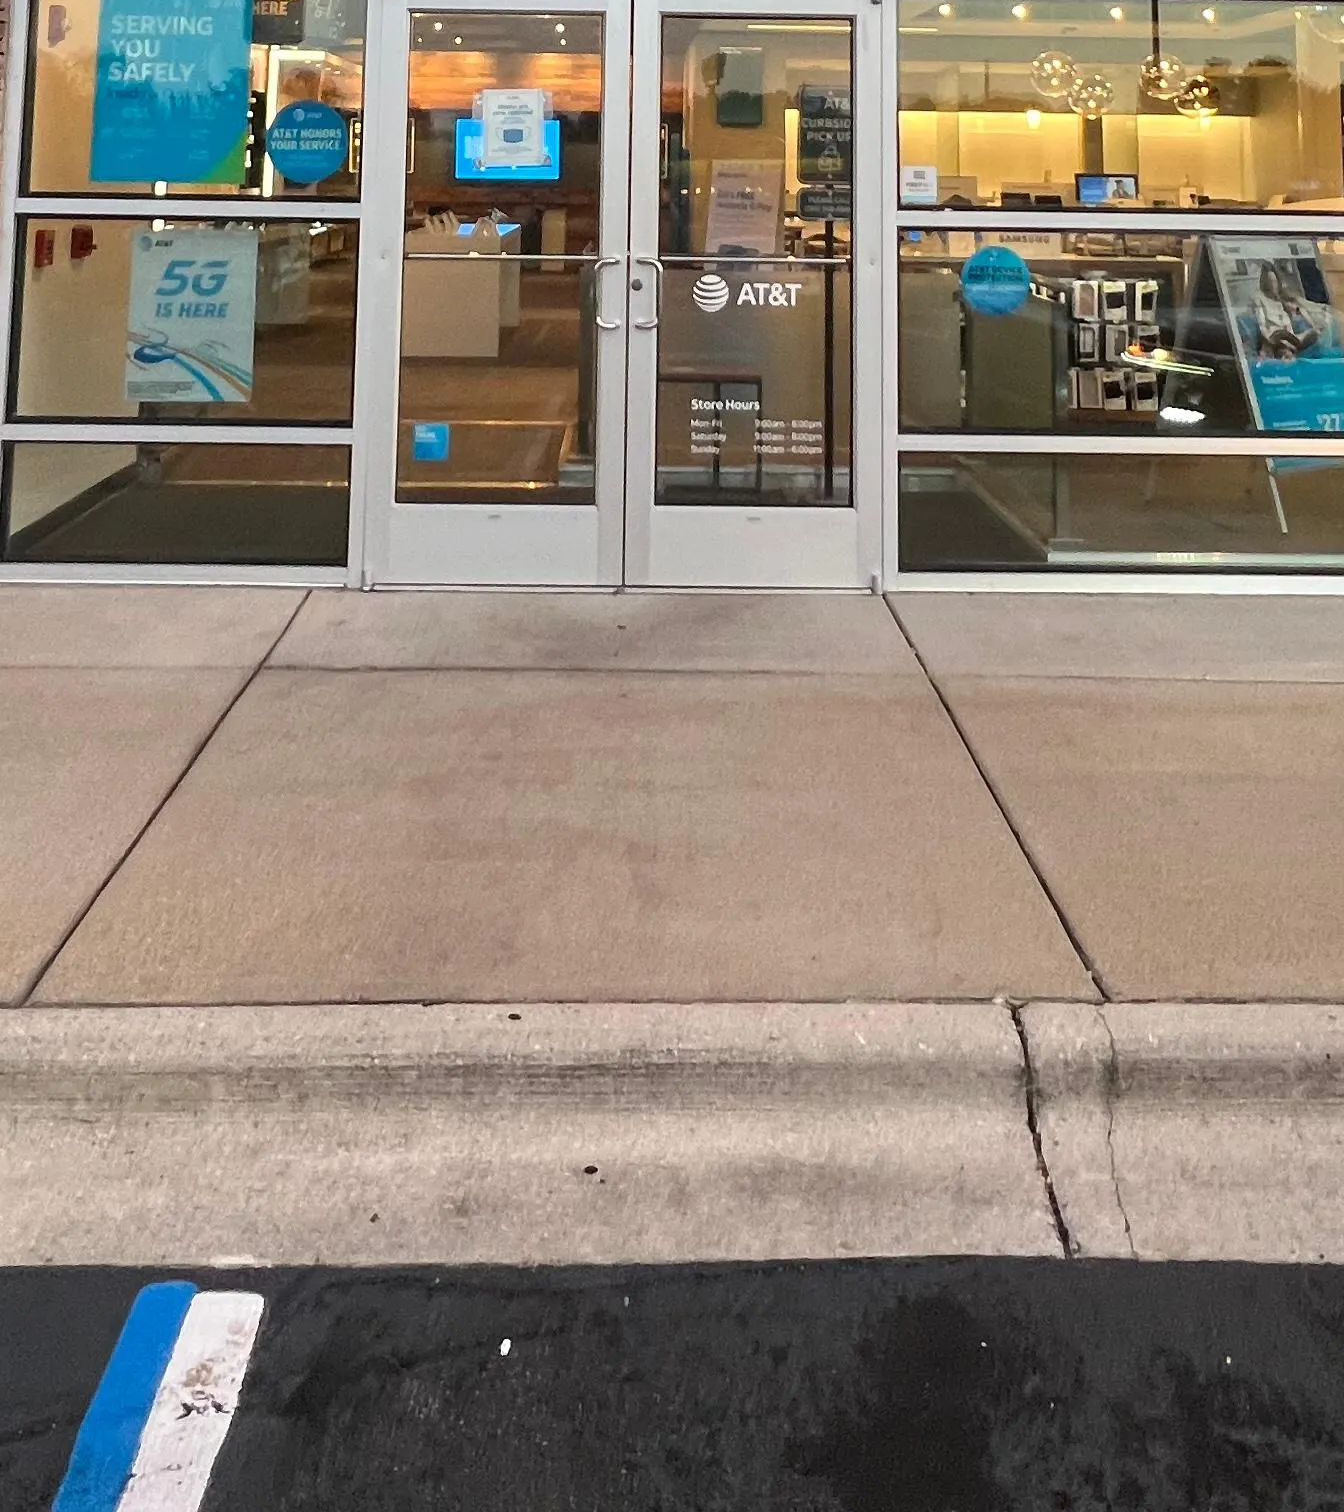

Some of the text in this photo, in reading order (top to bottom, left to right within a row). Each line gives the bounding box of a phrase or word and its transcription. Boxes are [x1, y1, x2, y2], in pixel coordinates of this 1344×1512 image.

[110, 15, 213, 36] SERVING
[111, 39, 160, 59] YOU
[107, 62, 196, 83] SAFELY
[824, 97, 850, 109] AT&
[801, 118, 851, 128] CURBSID
[272, 128, 343, 139] AT&T HONORS
[270, 140, 297, 150] YOUR
[155, 260, 231, 297] 5G
[736, 282, 802, 307] AT&T
[157, 302, 230, 319] IS HERE
[691, 399, 760, 410] Store Hours
[691, 432, 726, 442] Saturday
